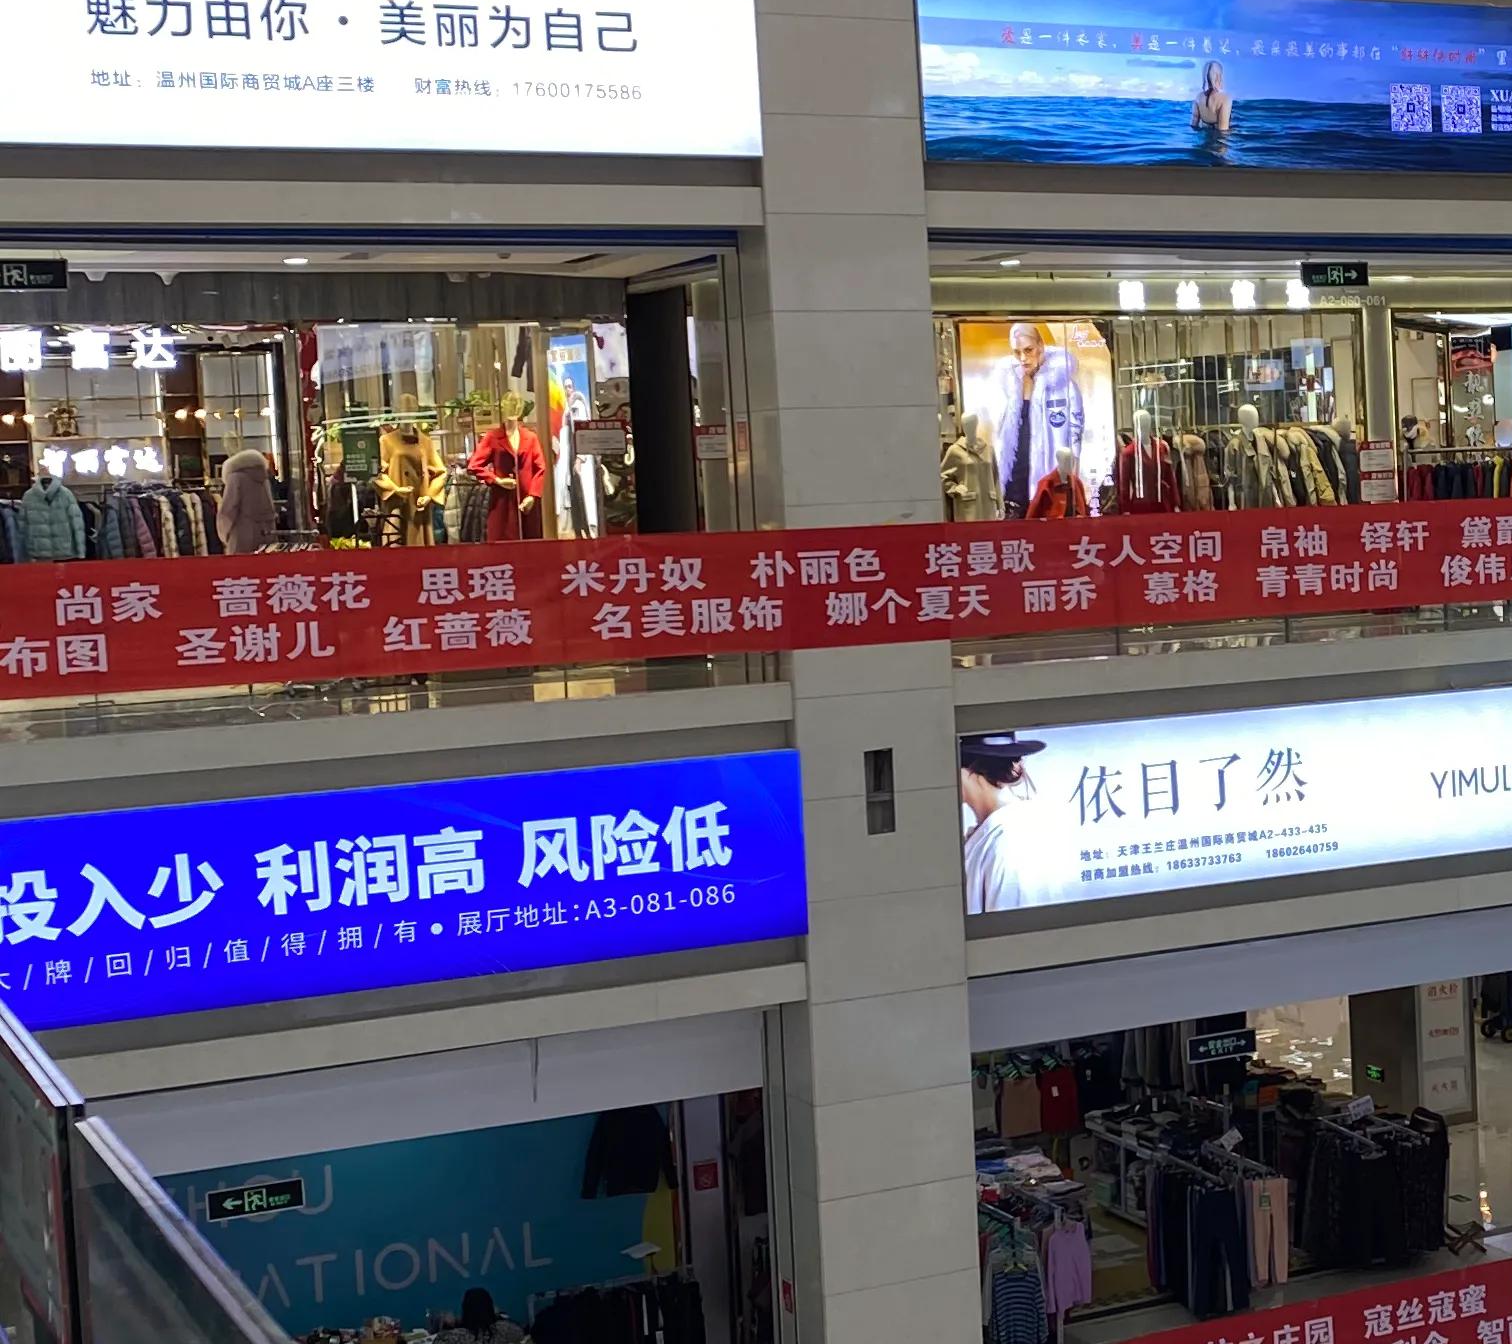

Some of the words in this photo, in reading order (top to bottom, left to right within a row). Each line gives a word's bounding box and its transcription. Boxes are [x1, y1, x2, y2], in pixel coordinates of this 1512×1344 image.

[0, 633, 109, 678] 布图
[174, 621, 336, 668] 圣谢儿
[383, 608, 534, 654] 红蔷薇
[591, 593, 784, 641] 名美服饰
[824, 584, 990, 628] 娜个夏天
[1023, 575, 1097, 613] 丽乔
[1142, 568, 1219, 606] 慕格
[1256, 559, 1398, 598] 青青时尚
[55, 582, 163, 626] 尚家
[212, 571, 371, 618] 蔷薇花
[418, 563, 518, 606] 思瑶
[561, 554, 706, 597] 米丹奴
[750, 547, 887, 589] 朴丽色
[925, 538, 1036, 579] 塔曼歌
[1068, 529, 1223, 570] 女人空间
[1260, 524, 1328, 559] 帛袖
[1068, 746, 1309, 827] 依目了然
[256, 824, 486, 918] 利润高
[517, 799, 733, 889] 风险低
